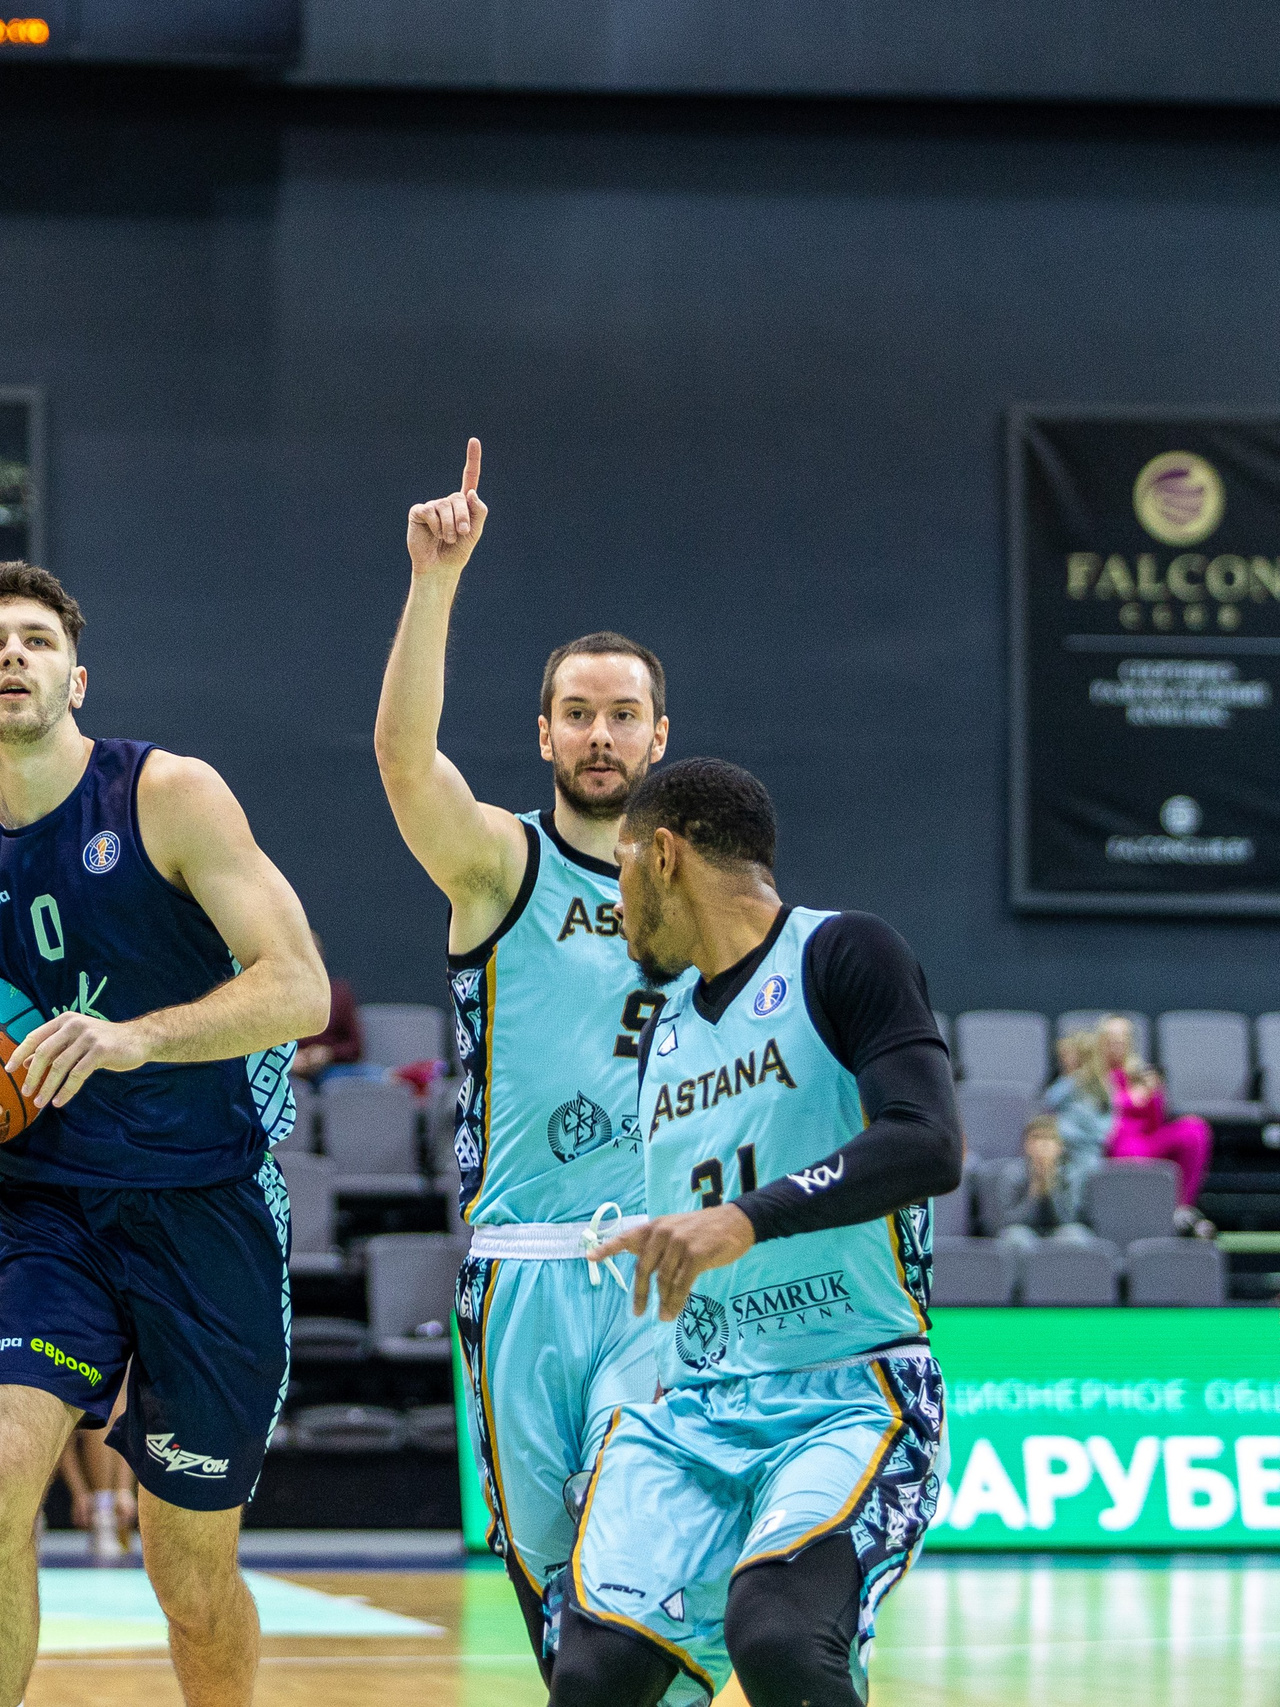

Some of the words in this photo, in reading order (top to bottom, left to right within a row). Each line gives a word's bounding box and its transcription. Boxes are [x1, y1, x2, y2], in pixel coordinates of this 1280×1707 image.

[30, 893, 64, 961] 0
[648, 1038, 798, 1143] ASTANA
[732, 1274, 849, 1323] SAMRUK
[738, 1302, 855, 1340] KAZYNA
